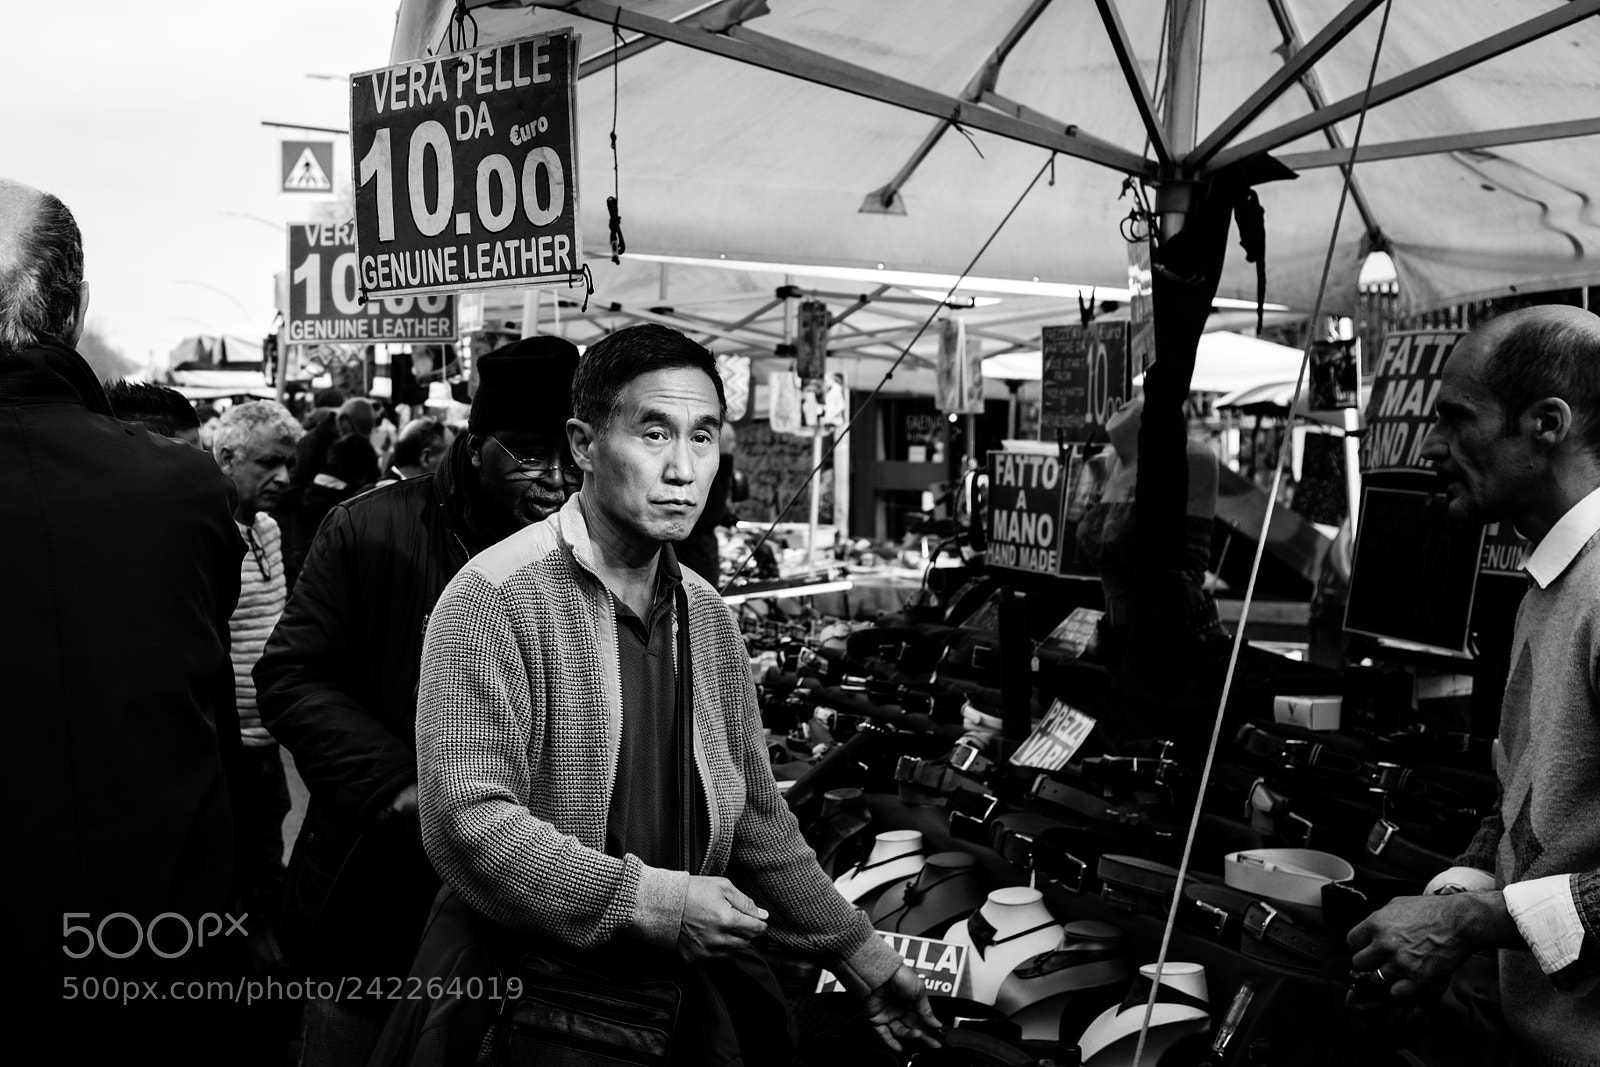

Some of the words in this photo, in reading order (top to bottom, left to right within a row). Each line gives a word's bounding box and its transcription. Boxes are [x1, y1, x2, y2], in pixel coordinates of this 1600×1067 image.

[371, 60, 448, 115] VERA
[454, 39, 552, 99] PELLE
[455, 100, 494, 142] DA
[359, 119, 565, 242] 10.00
[361, 246, 458, 290] GENUINE
[463, 234, 572, 280] LEATHER
[290, 321, 369, 340] GENUINE
[372, 317, 450, 336] LEATHER
[1377, 334, 1457, 377] FATT
[995, 454, 1060, 490] FATTO
[1015, 489, 1027, 510] A
[993, 509, 1054, 548] MANO
[986, 542, 1017, 567] HAND
[1019, 547, 1057, 573] MADE
[1019, 732, 1070, 771] VARI
